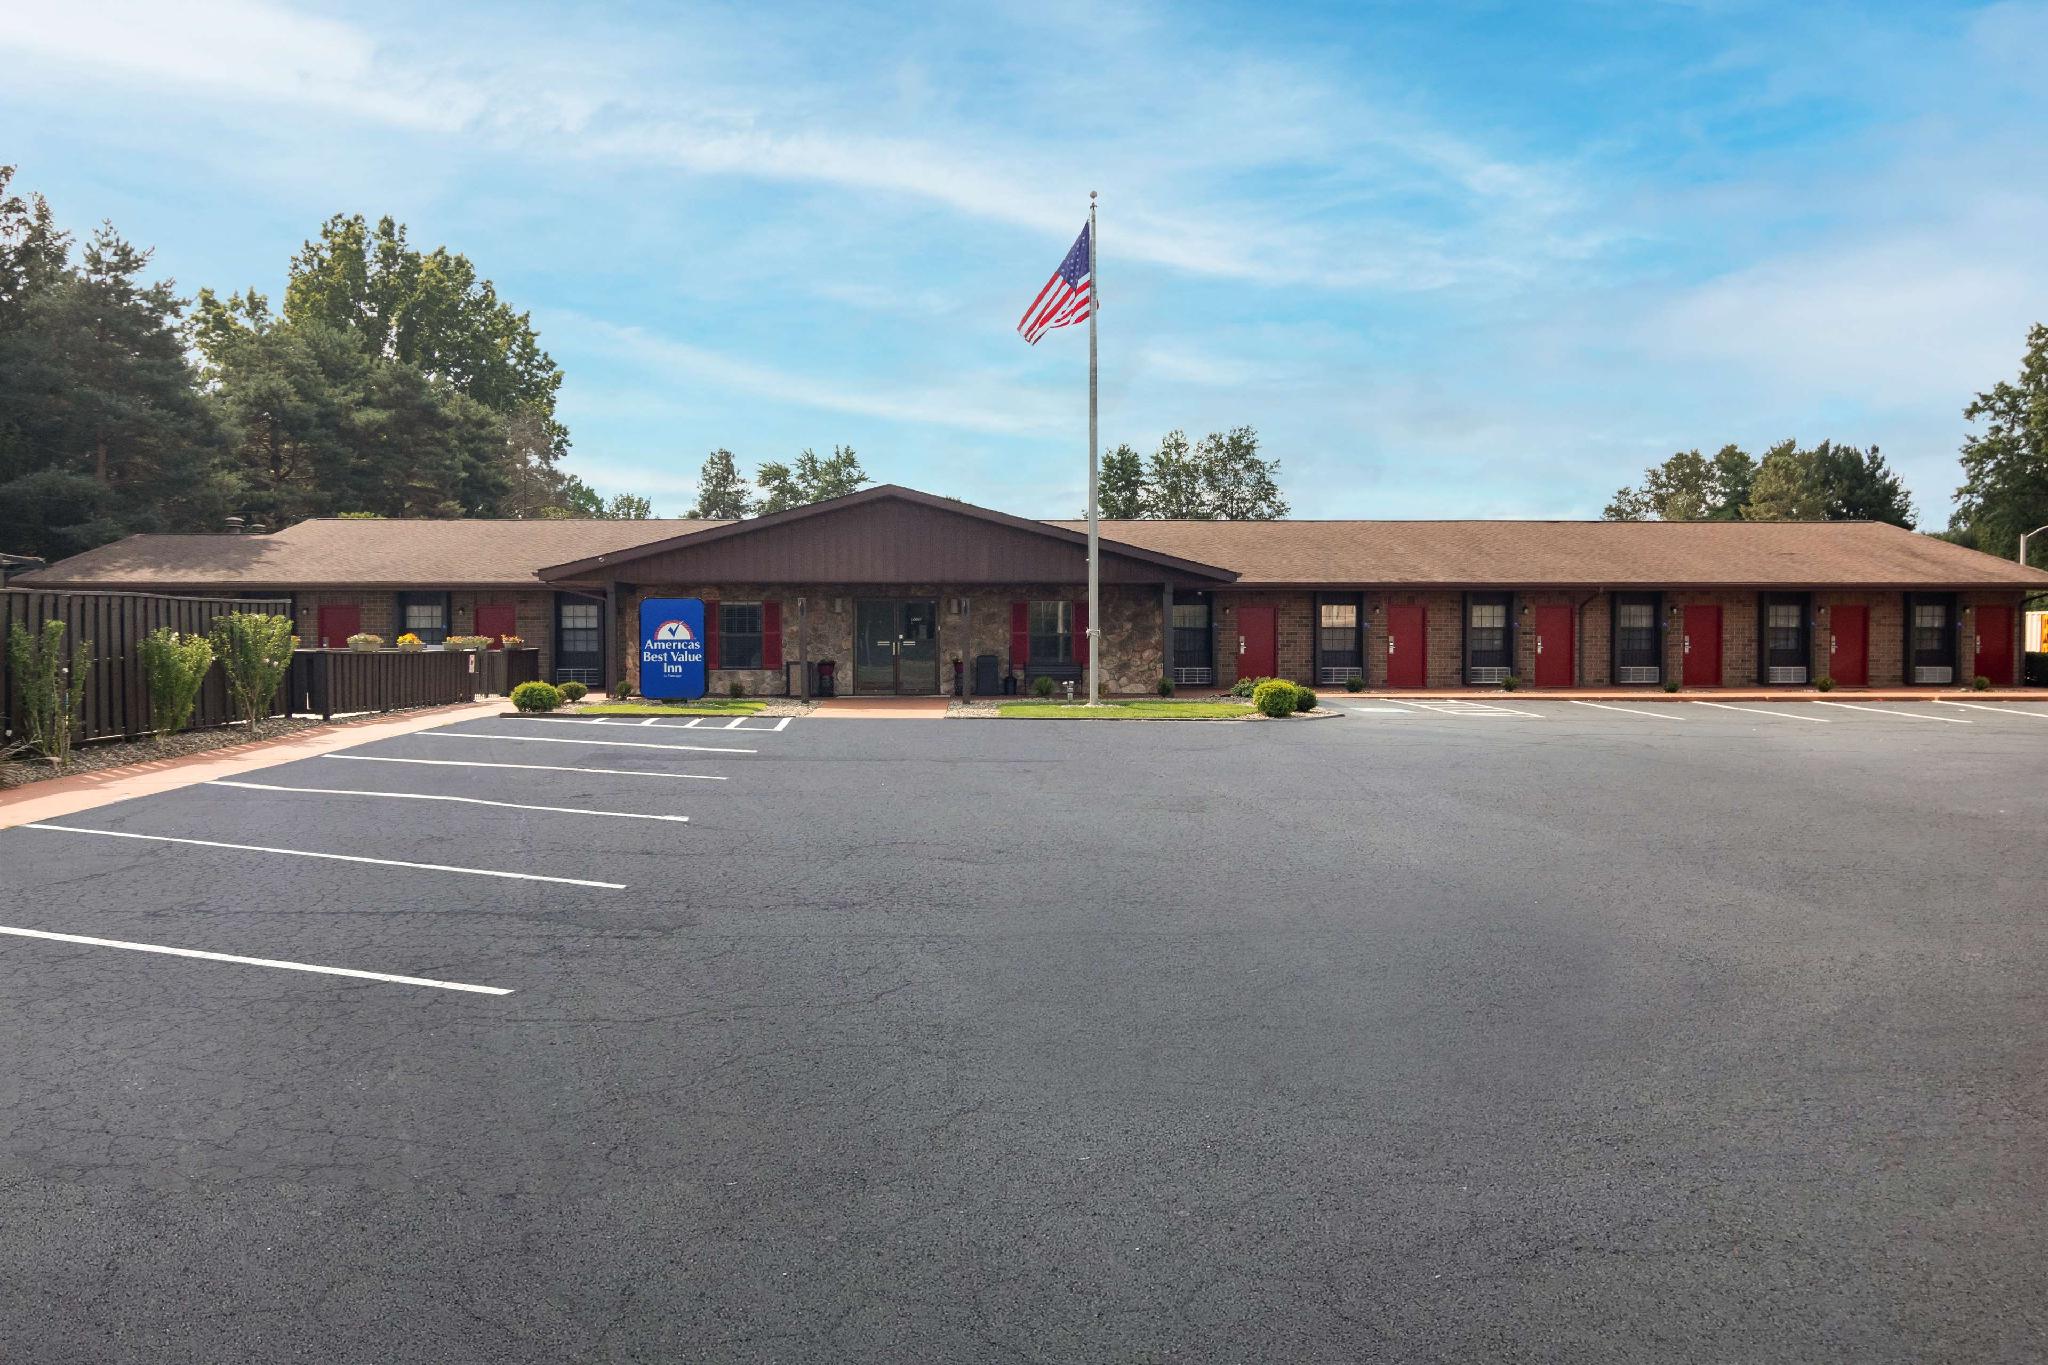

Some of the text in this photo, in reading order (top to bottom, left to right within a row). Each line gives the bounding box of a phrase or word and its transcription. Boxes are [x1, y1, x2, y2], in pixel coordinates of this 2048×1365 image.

[644, 639, 701, 650] Americas
[643, 651, 702, 662] Best Value
[663, 662, 683, 673] Inn
